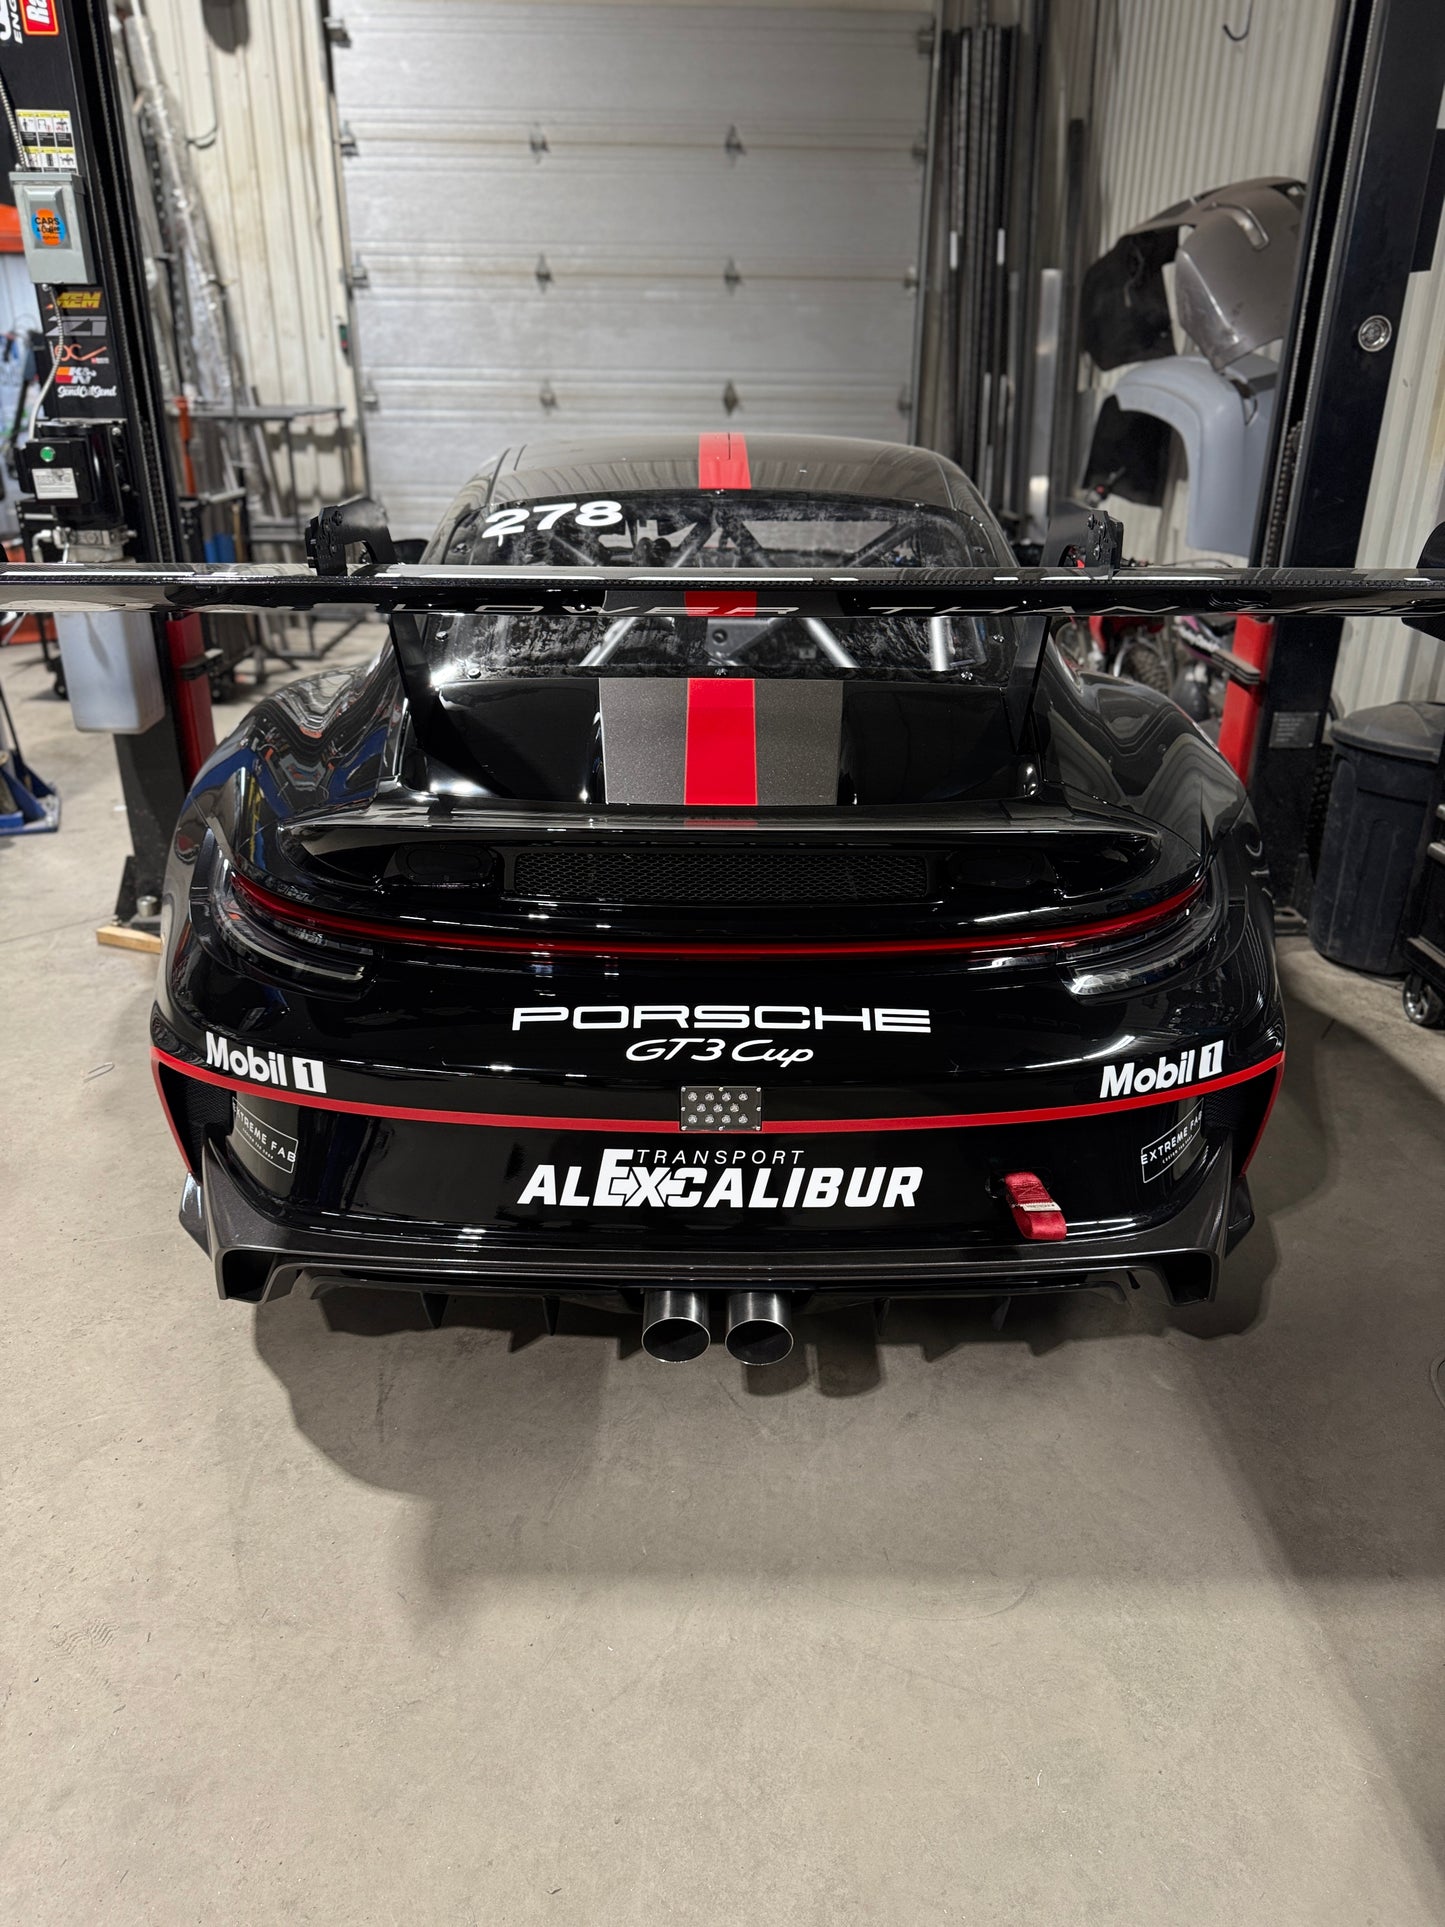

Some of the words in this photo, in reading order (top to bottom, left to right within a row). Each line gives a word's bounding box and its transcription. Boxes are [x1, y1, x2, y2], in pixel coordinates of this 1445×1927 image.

[34, 217, 60, 225] CARS
[481, 500, 623, 539] 278
[868, 605, 1181, 615] THAN
[511, 1005, 932, 1033] PORSCHE
[205, 1031, 288, 1087] Mobil
[731, 1038, 815, 1068] Cup
[1099, 1049, 1196, 1099] Mobil
[232, 1101, 267, 1145] EXTREME
[271, 1140, 296, 1163] FAB
[1140, 1125, 1188, 1166] EXTREME
[637, 1149, 805, 1165] TRANSPORT
[517, 1148, 923, 1209] ALEXCALIBUR
